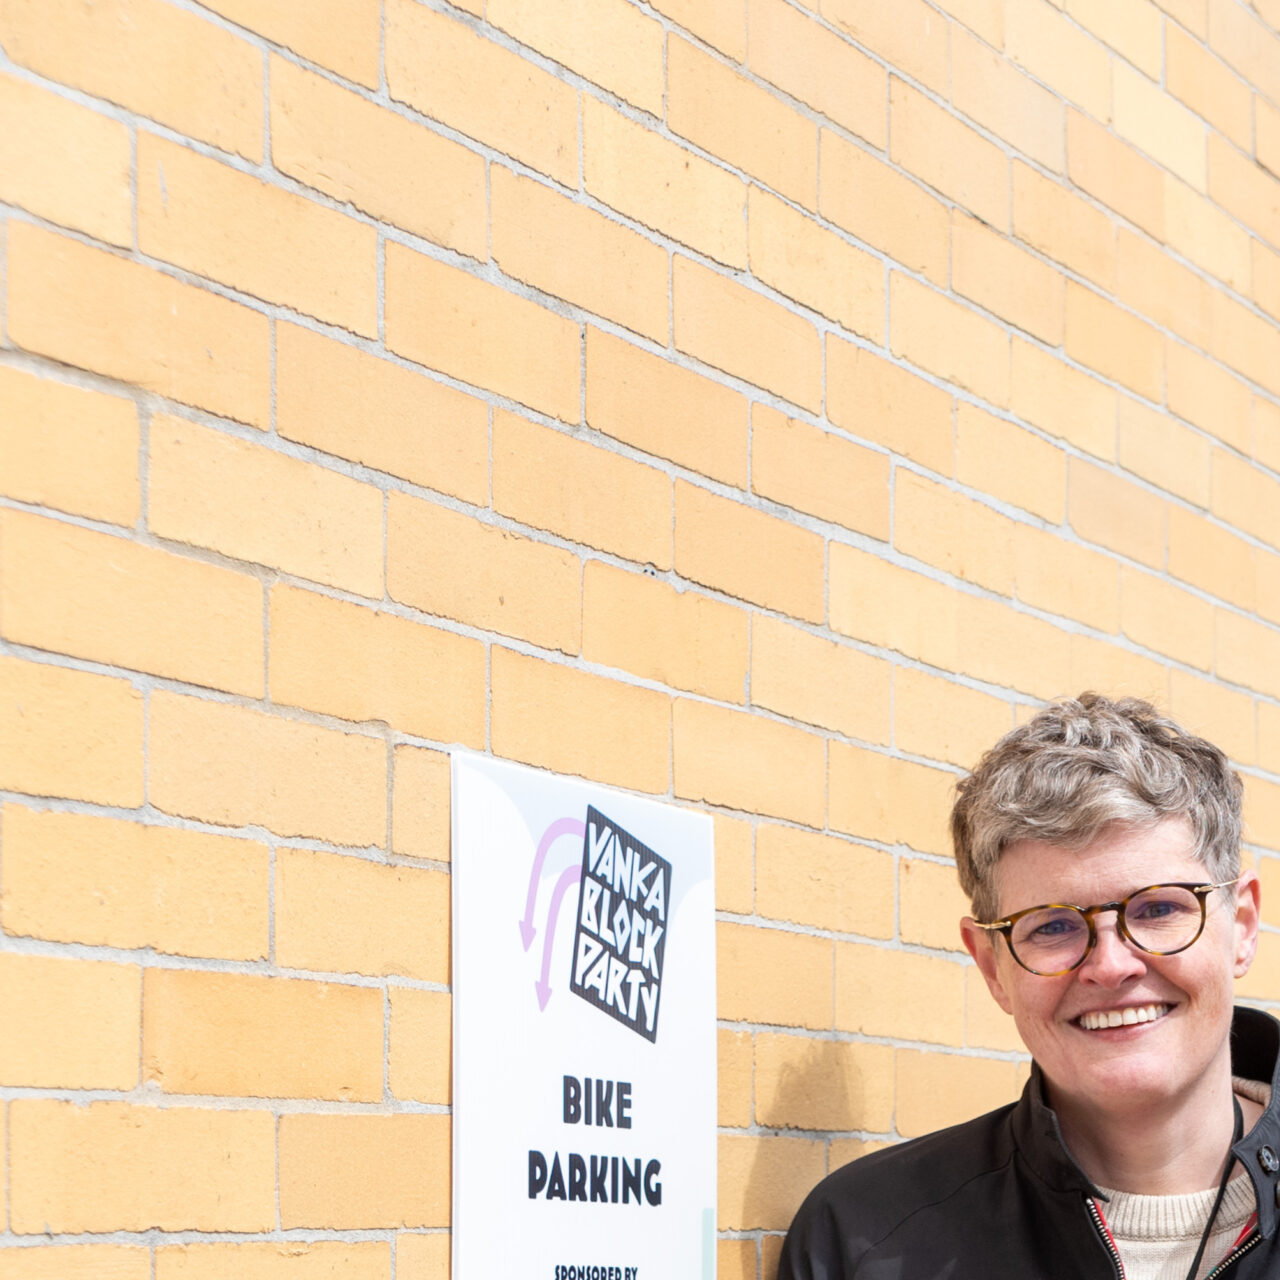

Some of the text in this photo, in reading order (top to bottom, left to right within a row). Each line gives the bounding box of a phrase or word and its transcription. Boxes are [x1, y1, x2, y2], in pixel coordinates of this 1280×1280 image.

[587, 821, 666, 922] VANKA
[580, 875, 664, 980] BLOCK
[574, 931, 659, 1032] PARTY
[562, 1075, 632, 1129] BIKE
[528, 1150, 662, 1206] PARKING
